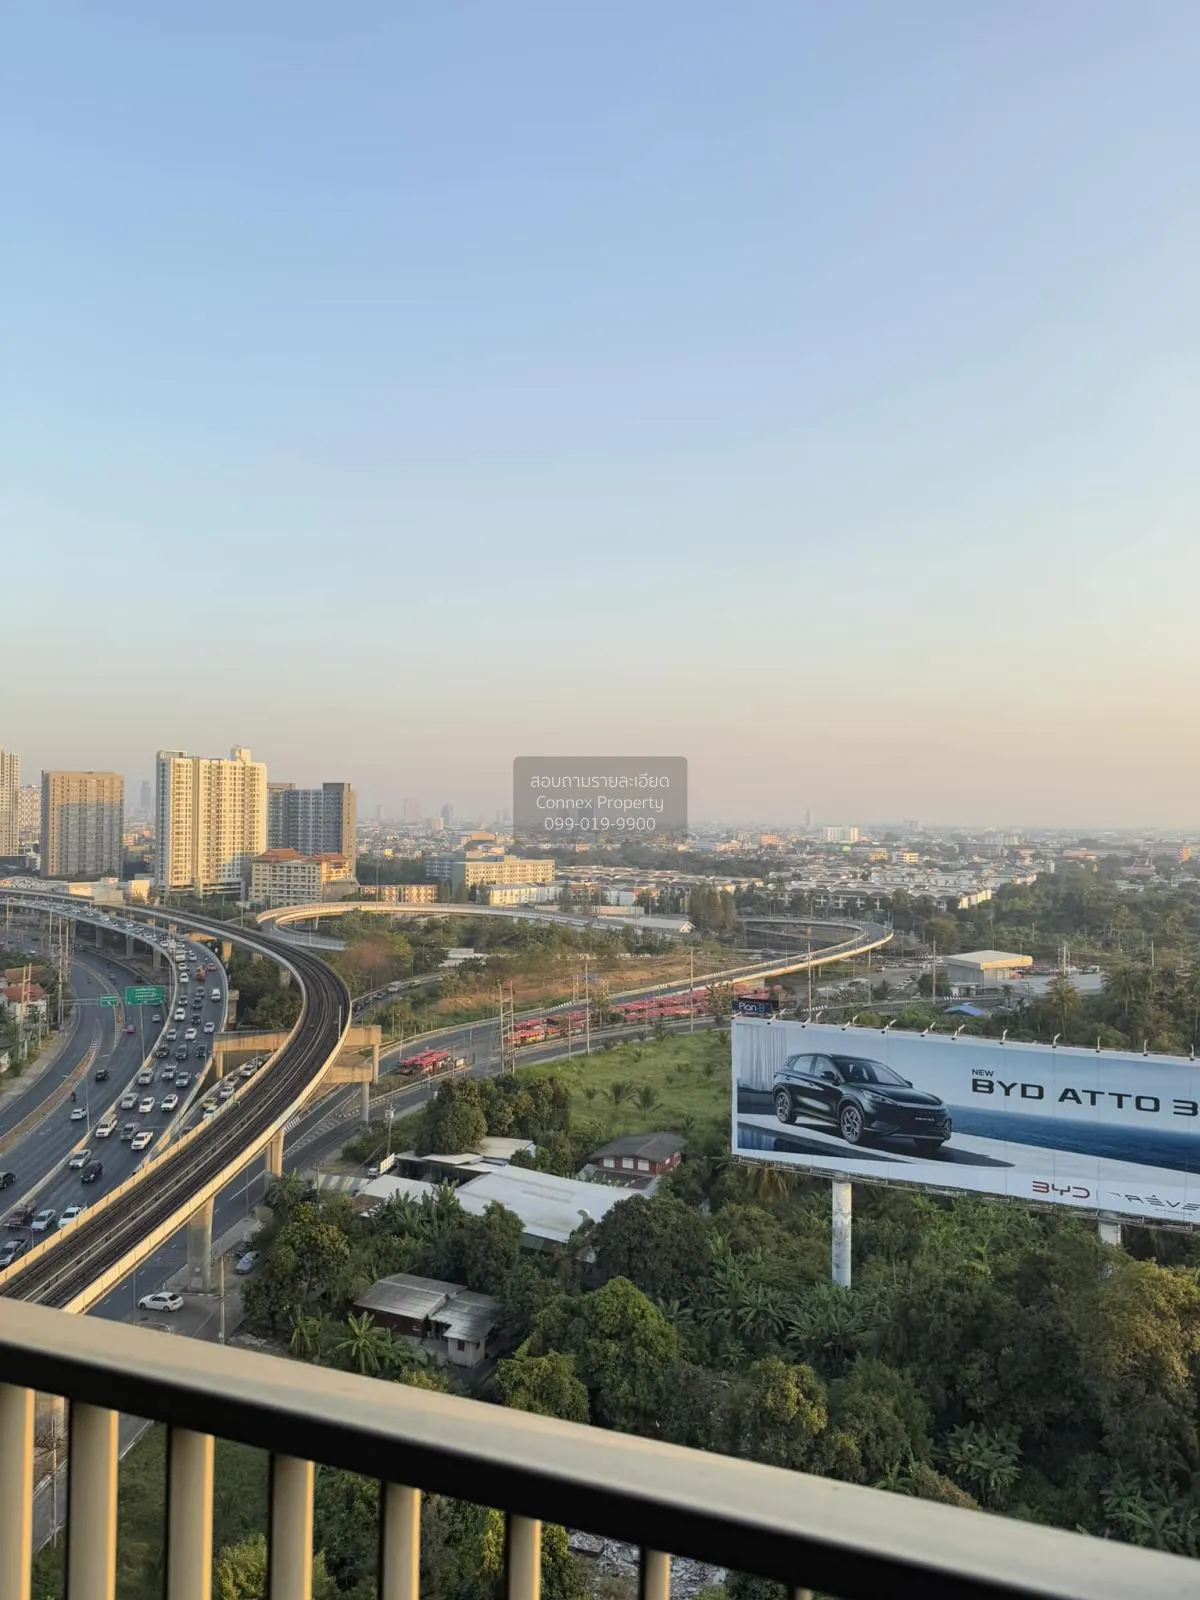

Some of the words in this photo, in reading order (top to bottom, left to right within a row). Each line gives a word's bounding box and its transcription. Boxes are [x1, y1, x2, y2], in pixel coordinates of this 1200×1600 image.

[971, 1068, 994, 1077] NEW
[971, 1078, 1044, 1100] BYD
[1058, 1087, 1160, 1113] ATTO
[1172, 1098, 1199, 1117] 3
[1032, 1180, 1090, 1199] BYD
